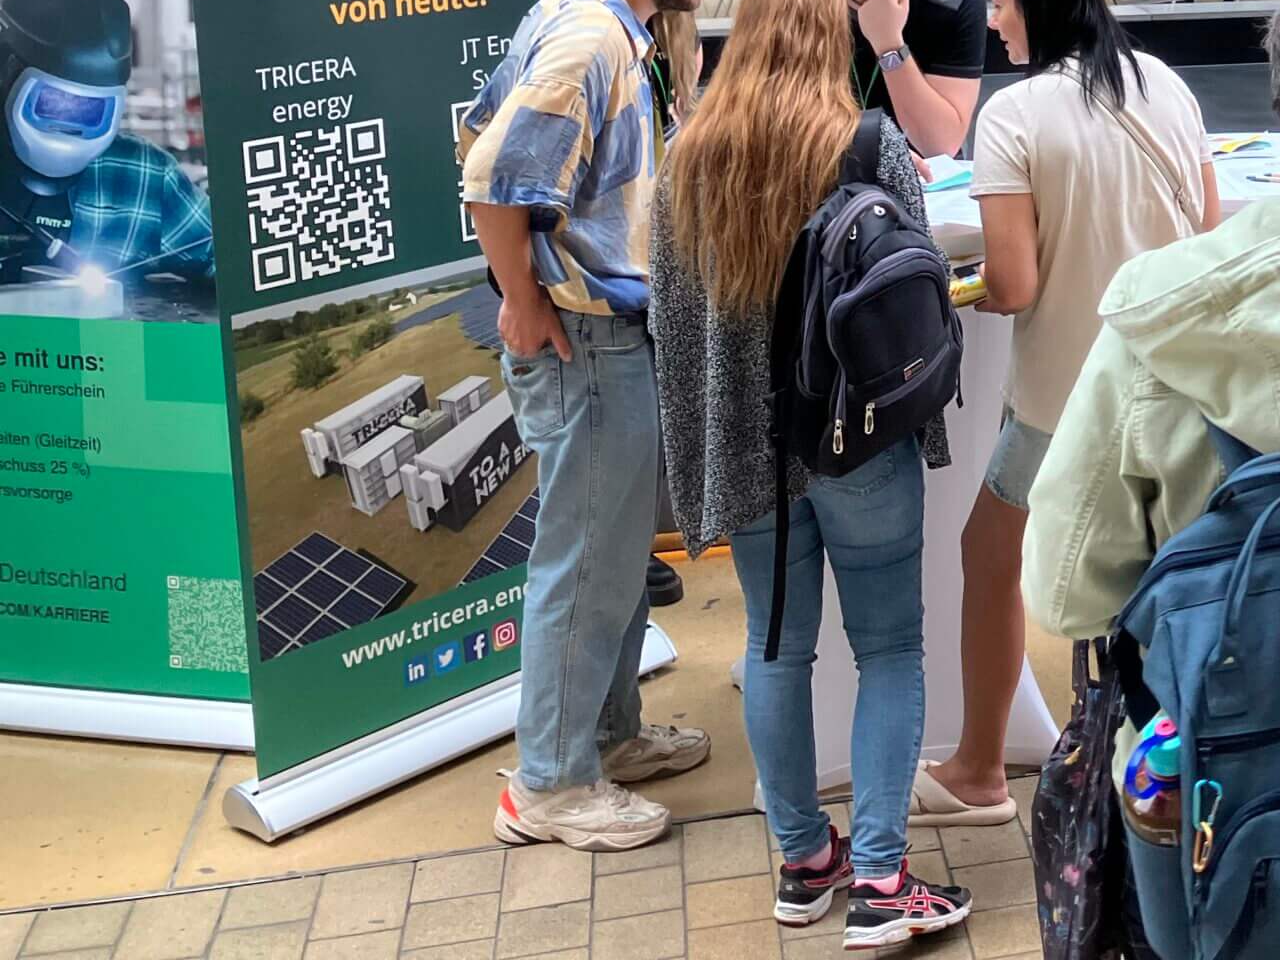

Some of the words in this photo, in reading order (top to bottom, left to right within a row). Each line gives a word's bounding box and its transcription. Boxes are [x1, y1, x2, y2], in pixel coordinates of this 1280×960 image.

[460, 37, 481, 65] JT
[255, 55, 357, 91] TRICERA
[272, 94, 353, 123] energy
[14, 348, 49, 368] mit
[56, 353, 105, 372] uns:
[11, 378, 105, 399] Führerschein
[35, 432, 102, 454] (Gleitzeit)
[50, 461, 68, 475] 25
[468, 455, 495, 488] TO
[475, 455, 512, 507] NEW
[0, 562, 127, 592] Deutschland
[341, 581, 529, 669] www.tricera.en
